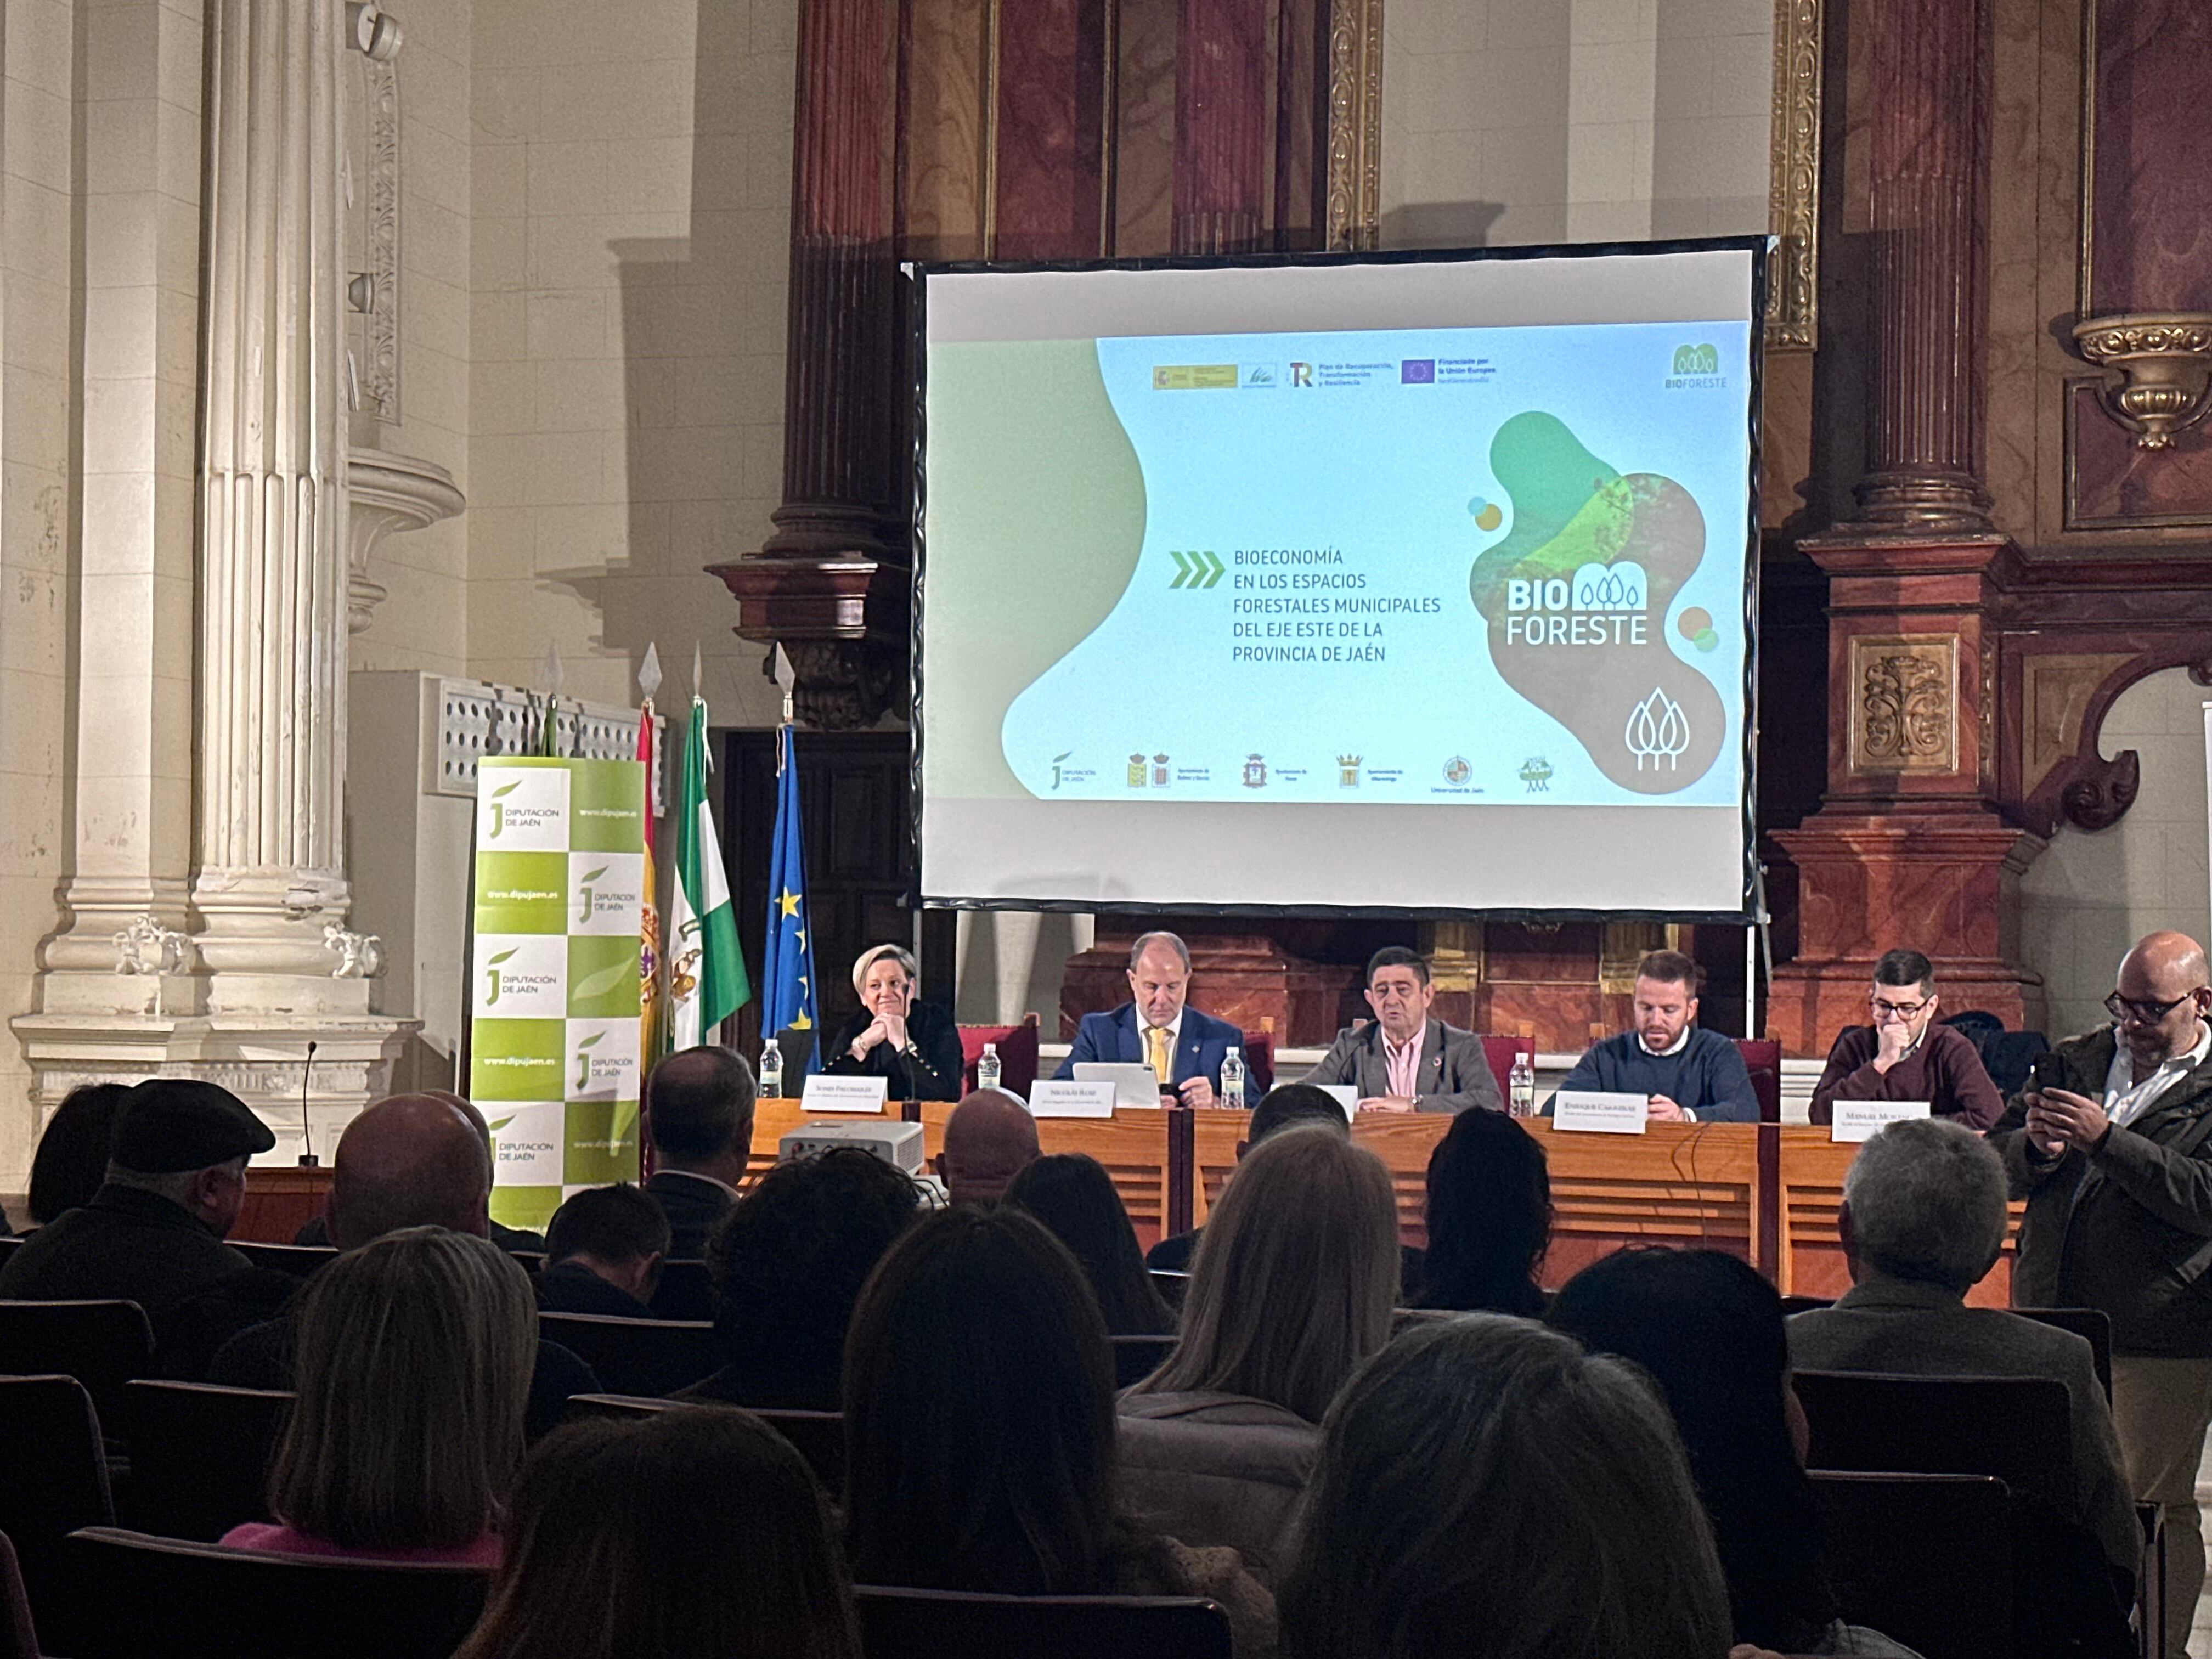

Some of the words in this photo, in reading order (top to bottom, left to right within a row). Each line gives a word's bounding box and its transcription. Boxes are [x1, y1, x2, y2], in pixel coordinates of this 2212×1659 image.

[1665, 377, 1727, 388] BIOFORESTE
[1235, 545, 1343, 565] BIOECONOMÍA
[1234, 574, 1254, 589] EN
[1260, 574, 1287, 589] LOS
[1293, 574, 1366, 589] ESPACIOS
[1508, 579, 1568, 611] BIO
[1234, 599, 1329, 613] FORESTALES
[1335, 598, 1440, 612] MUNICIPALES
[1234, 623, 1261, 637] DEL
[1267, 623, 1291, 637] EJE
[1297, 623, 1333, 637] ESTE
[1339, 623, 1358, 636] DE
[1364, 623, 1383, 636] LA
[1508, 616, 1647, 645] FORESTE
[1233, 647, 1316, 661] PROVINCIA
[1322, 646, 1341, 661] DE
[1346, 643, 1385, 661] JAÉN
[505, 808, 559, 817] DIPUTACIÓN
[519, 817, 540, 827] JAÉN
[487, 889, 558, 900] www.dipujaen.es
[606, 902, 623, 911] JAÉN
[502, 974, 556, 984] DIPUTACIÓN
[502, 985, 514, 994] DE
[516, 984, 538, 994] JAÉN
[484, 1057, 555, 1068] www.dipujaen.es
[591, 1058, 633, 1066] DIPUTACIÓN
[591, 1068, 601, 1076] DE
[604, 1067, 620, 1076] JAÉN
[499, 1141, 554, 1151] DIPUTACIÓN
[499, 1152, 510, 1160] DE
[514, 1151, 534, 1160] JAÉN
